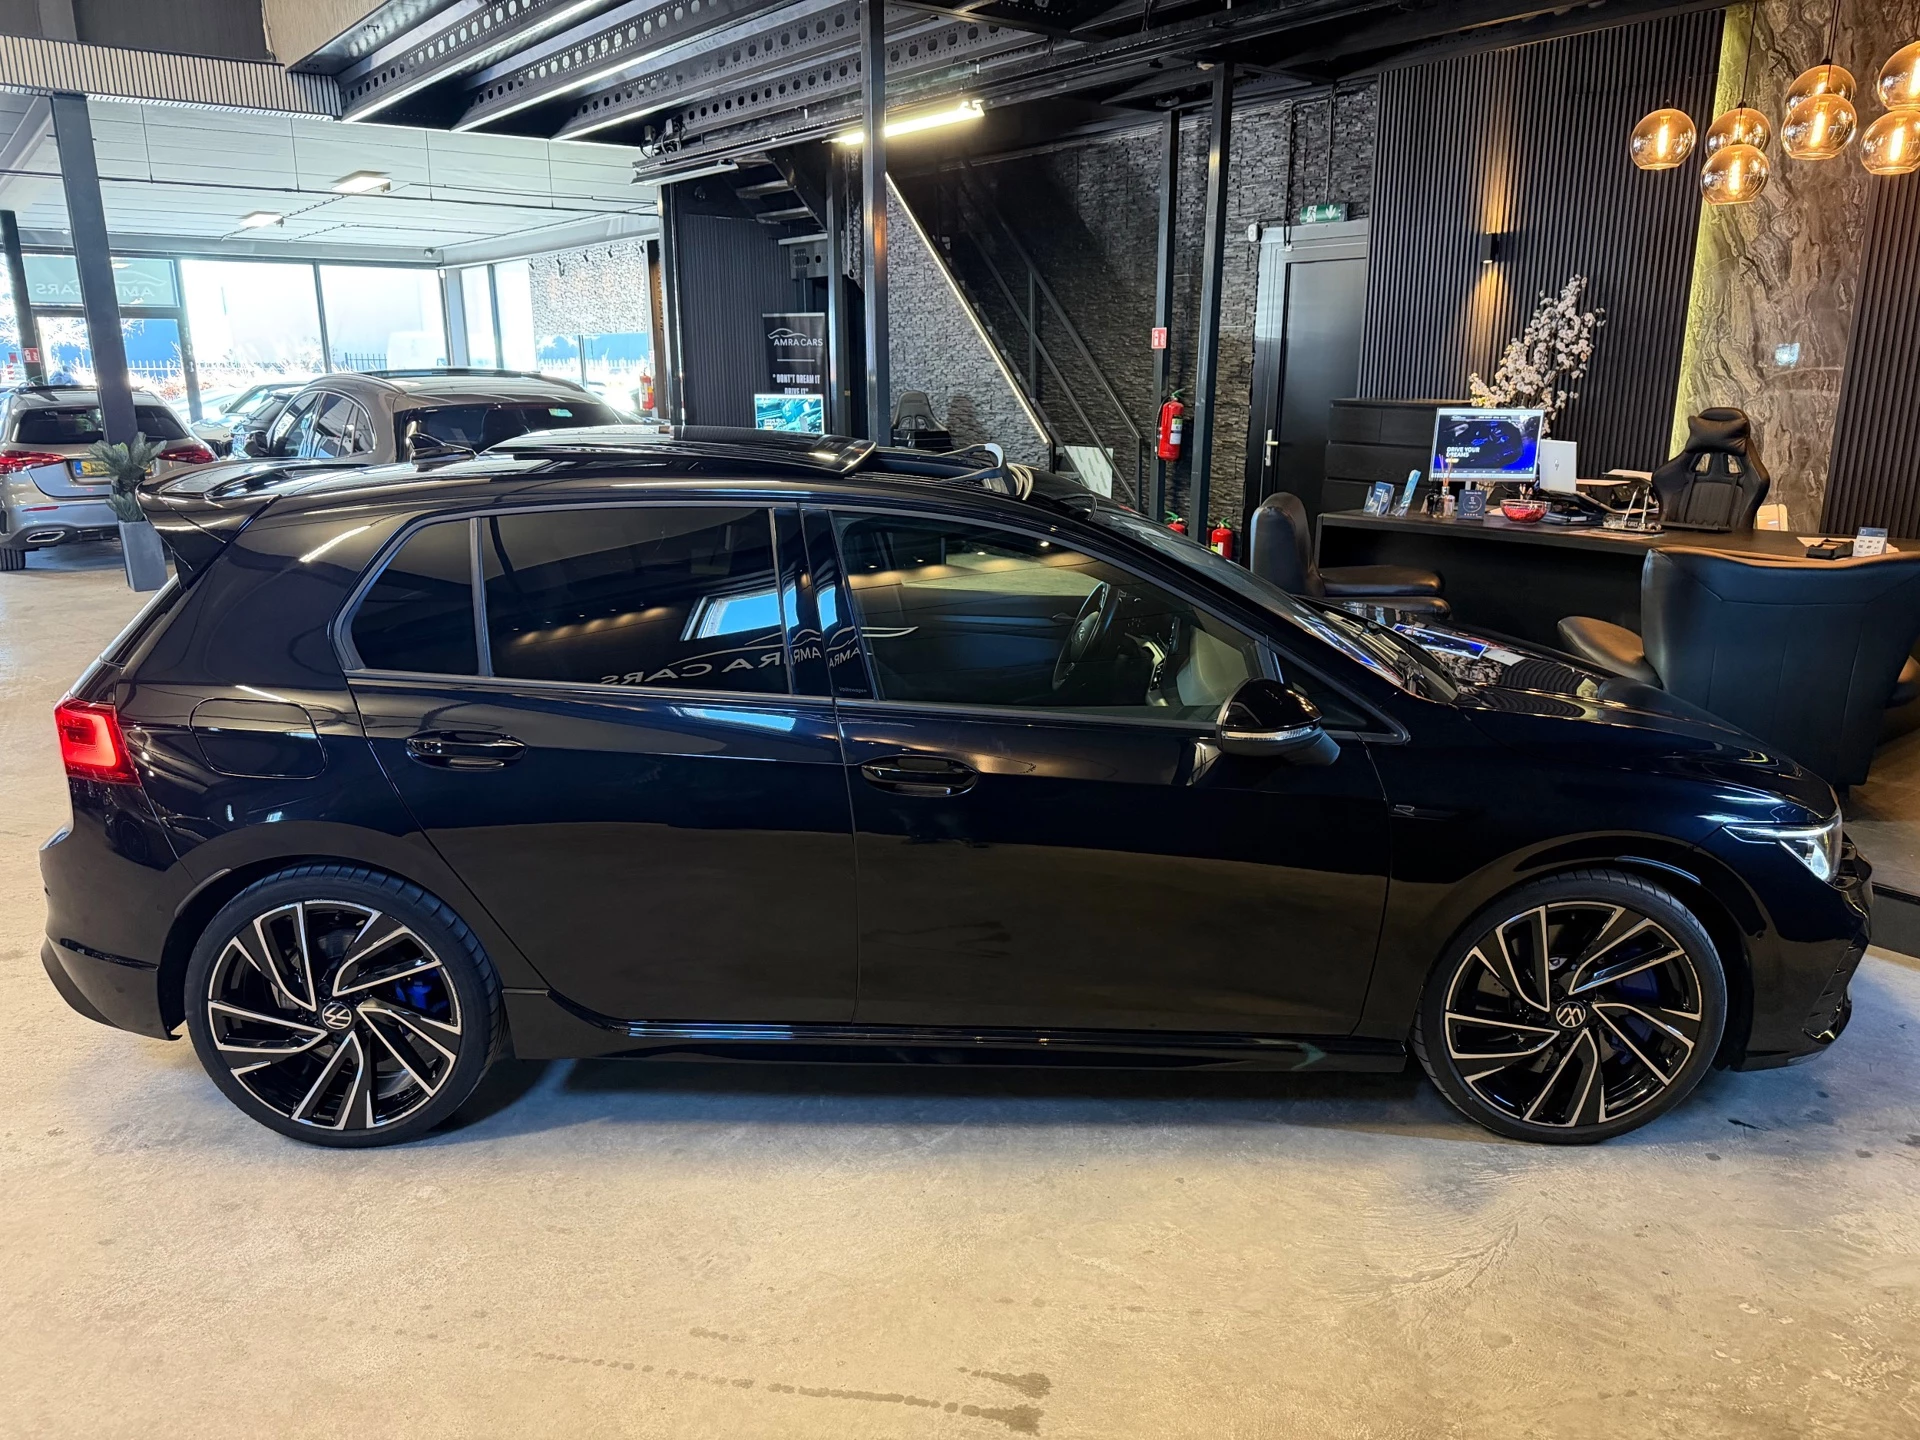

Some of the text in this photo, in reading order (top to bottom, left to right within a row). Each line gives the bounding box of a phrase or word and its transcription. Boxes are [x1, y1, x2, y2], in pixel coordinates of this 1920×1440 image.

[773, 338, 823, 347] AMRA CARS
[796, 374, 814, 384] DREAM
[814, 375, 820, 384] IT
